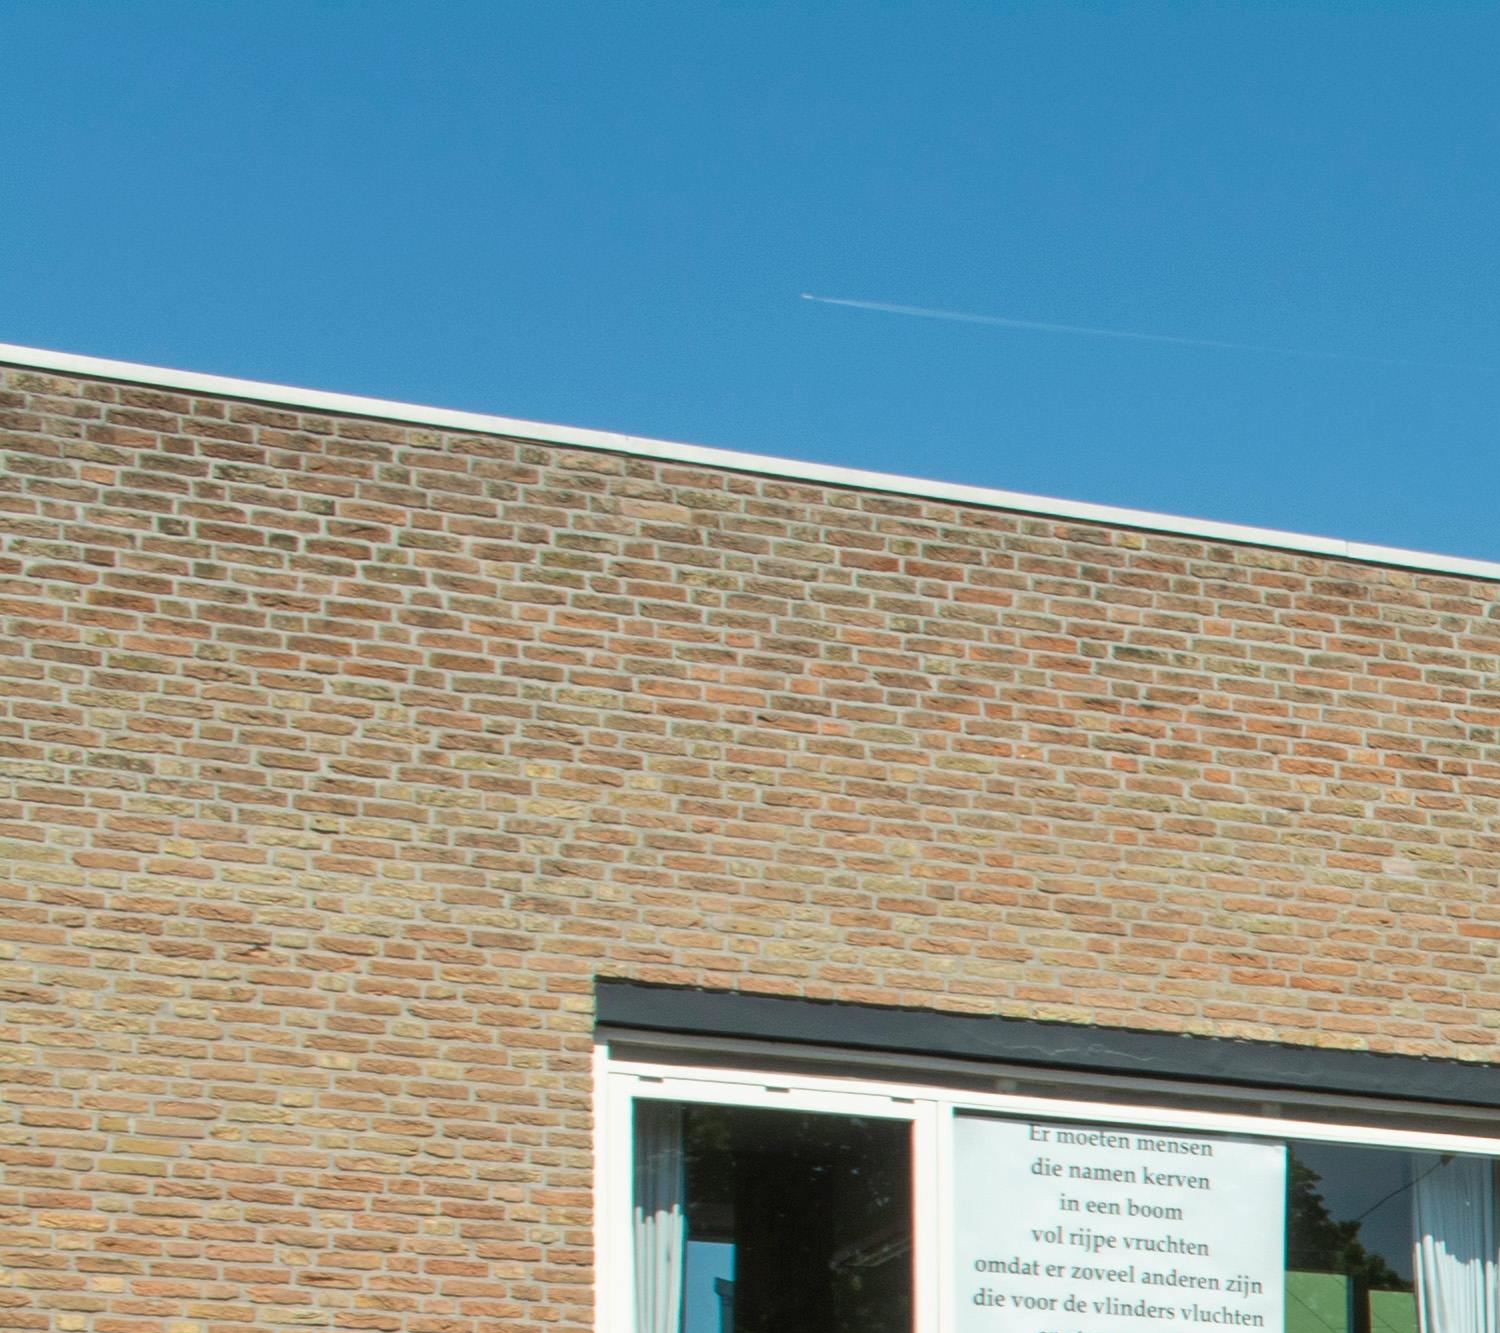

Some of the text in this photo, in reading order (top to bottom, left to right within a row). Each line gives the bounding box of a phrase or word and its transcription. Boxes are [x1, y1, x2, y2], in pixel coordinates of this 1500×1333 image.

[1028, 1123, 1213, 1156] Er moeten mensen
[1031, 1157, 1210, 1190] die namen kerven
[1060, 1193, 1183, 1220] in een boom
[1031, 1226, 1209, 1256] vol rijpe vruchten
[974, 1257, 1263, 1298] omdat er zoveel anderen zijn
[973, 1288, 1264, 1327] die voor de vlinders vluchten
